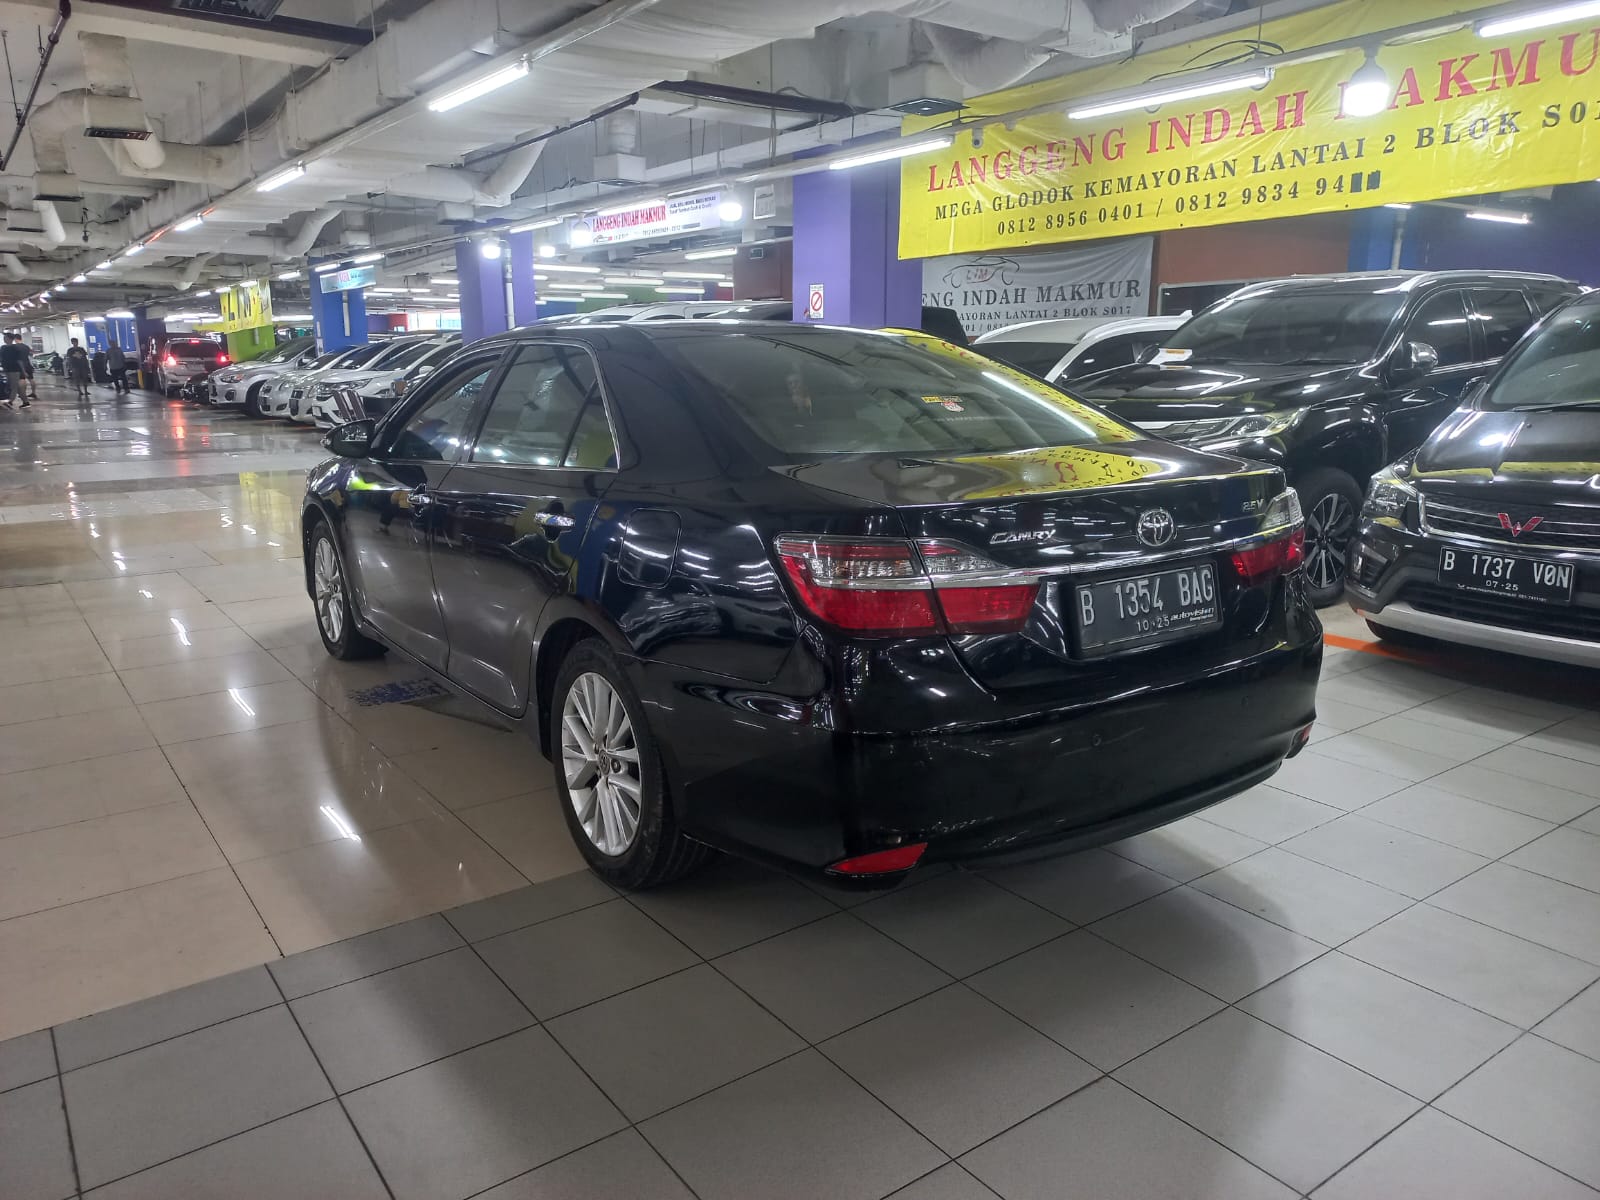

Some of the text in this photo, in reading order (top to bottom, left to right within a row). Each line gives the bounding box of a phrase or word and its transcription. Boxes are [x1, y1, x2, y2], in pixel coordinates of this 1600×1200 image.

[928, 127, 1127, 192] LANGGENG
[1146, 90, 1309, 154] INDAH
[935, 200, 983, 221] MEGA
[992, 185, 1075, 212] GLODOK
[1084, 159, 1238, 199] KEMAYORAN
[1251, 138, 1366, 173] LANTAI
[1383, 134, 1396, 154] 2
[1414, 111, 1522, 149] BLOK
[592, 213, 621, 232] LANGGENG
[621, 209, 640, 228] INDAH
[640, 204, 666, 225] MAKMUR
[998, 217, 1036, 236] 0812
[1045, 210, 1088, 230] 8956
[1098, 202, 1144, 223] 0401
[1155, 198, 1164, 217] /
[1175, 191, 1228, 213] 0812
[1241, 181, 1299, 205] 9834
[962, 287, 1026, 306] INDAH
[1036, 279, 1142, 302] MAKMUR
[1006, 309, 1048, 320] LANTAI
[1052, 309, 1059, 318] 2
[1063, 307, 1098, 317] BLOK
[1102, 306, 1132, 316] S017
[990, 529, 1057, 545] CAMRY
[1443, 551, 1456, 571] B
[1471, 554, 1516, 580] 1737
[1080, 569, 1214, 626] B 1354 BAG
